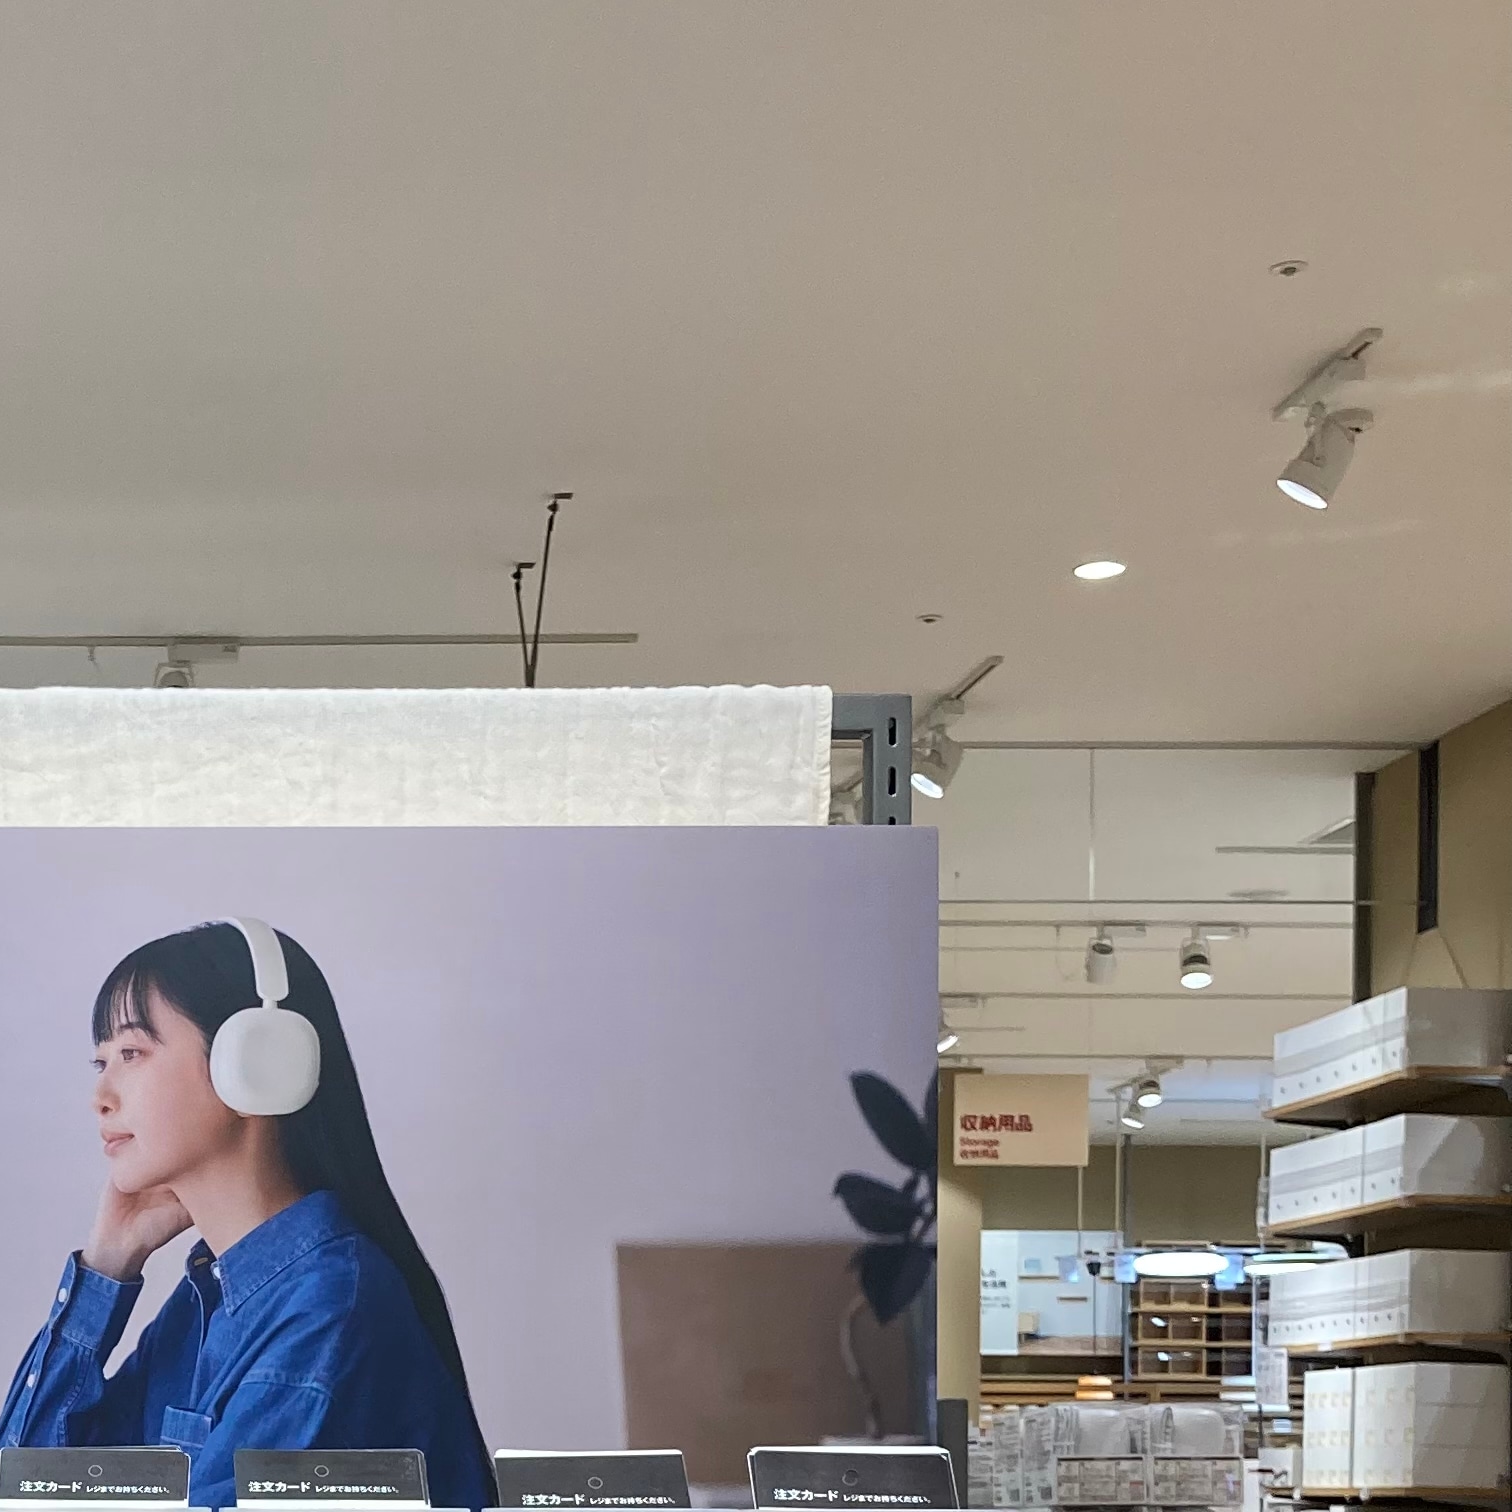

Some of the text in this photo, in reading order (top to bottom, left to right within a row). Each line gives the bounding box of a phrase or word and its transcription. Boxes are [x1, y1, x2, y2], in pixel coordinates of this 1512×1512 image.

[19, 1480, 83, 1493] 注文カード
[247, 1480, 311, 1493] 注文カード
[521, 1493, 585, 1506] 注文カード
[773, 1488, 839, 1502] 注文カード
